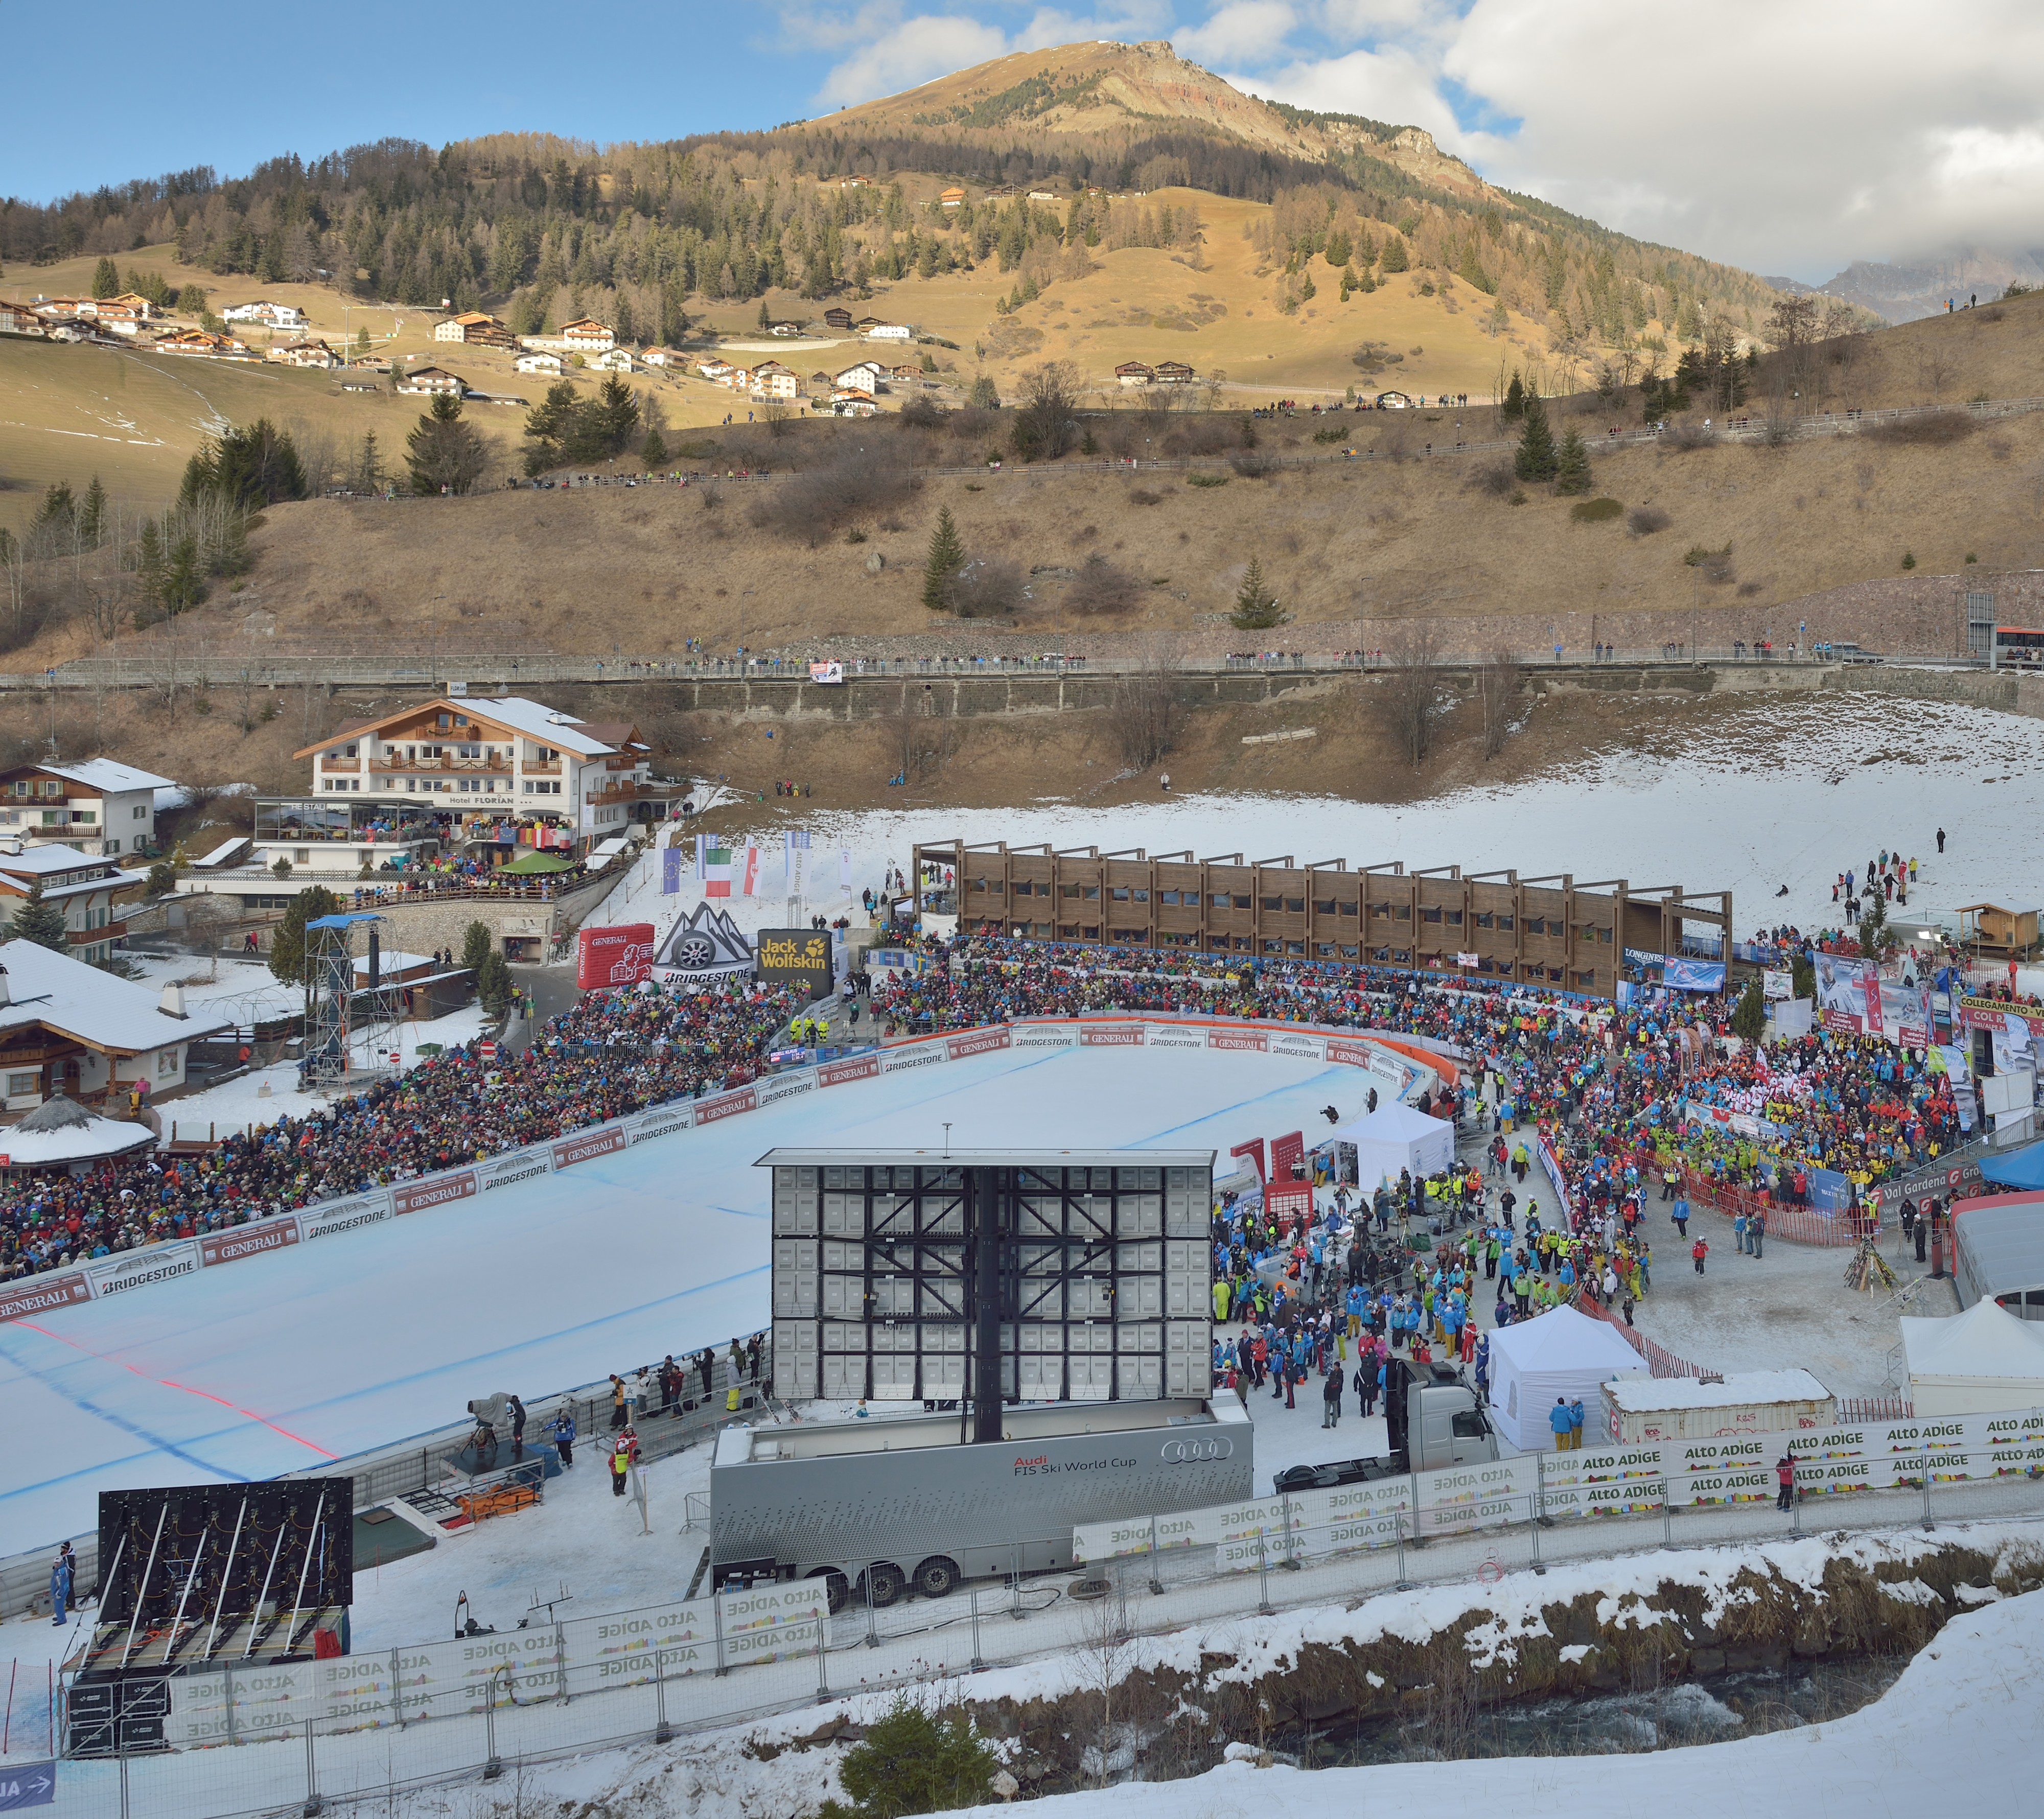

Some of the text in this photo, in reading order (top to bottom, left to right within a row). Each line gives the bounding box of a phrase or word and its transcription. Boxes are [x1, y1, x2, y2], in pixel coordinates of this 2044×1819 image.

[475, 796, 514, 804] FLORIAN
[592, 936, 627, 946] GENERALI
[761, 939, 798, 953] Jack
[761, 953, 826, 969] Wolfskin
[1625, 948, 1664, 963] LONGINES
[663, 968, 749, 984] BRIDGESTONE
[1961, 998, 2028, 1014] COLLEGAMENTO
[1973, 1011, 1994, 1022] COL
[1962, 1020, 1998, 1031] OTISEI/ALPE
[961, 1039, 1000, 1054] GENERALI
[1092, 1034, 1134, 1043] GENERALI
[1150, 1038, 1202, 1047] BRIDGESTONE
[1219, 1039, 1258, 1050] GENERALI
[1272, 1045, 1320, 1059] BRIDGESTONE
[886, 1054, 942, 1072] BRIDGESTONE
[830, 1066, 868, 1082] GENERALI
[1372, 1064, 1399, 1083] BRIDGESTONE
[762, 1082, 812, 1104] BRIDGESTONE
[707, 1100, 746, 1119] GENERALI
[632, 1121, 689, 1144] BRIDGESTONE
[568, 1139, 613, 1161] GENERALI
[485, 1163, 548, 1191] BRIDGESTONE
[1884, 1185, 1901, 1200] Val
[1904, 1175, 1946, 1194] Gardena
[410, 1184, 462, 1208] GENERALI
[309, 1209, 386, 1239] BRIDGESTONE
[221, 1233, 282, 1258] GENERALI
[103, 1261, 193, 1295] BRIDGESTONE
[0, 1289, 69, 1317] GENERALI
[1014, 1455, 1048, 1466] Audi
[1014, 1457, 1137, 1476] FIS Ski World Cup
